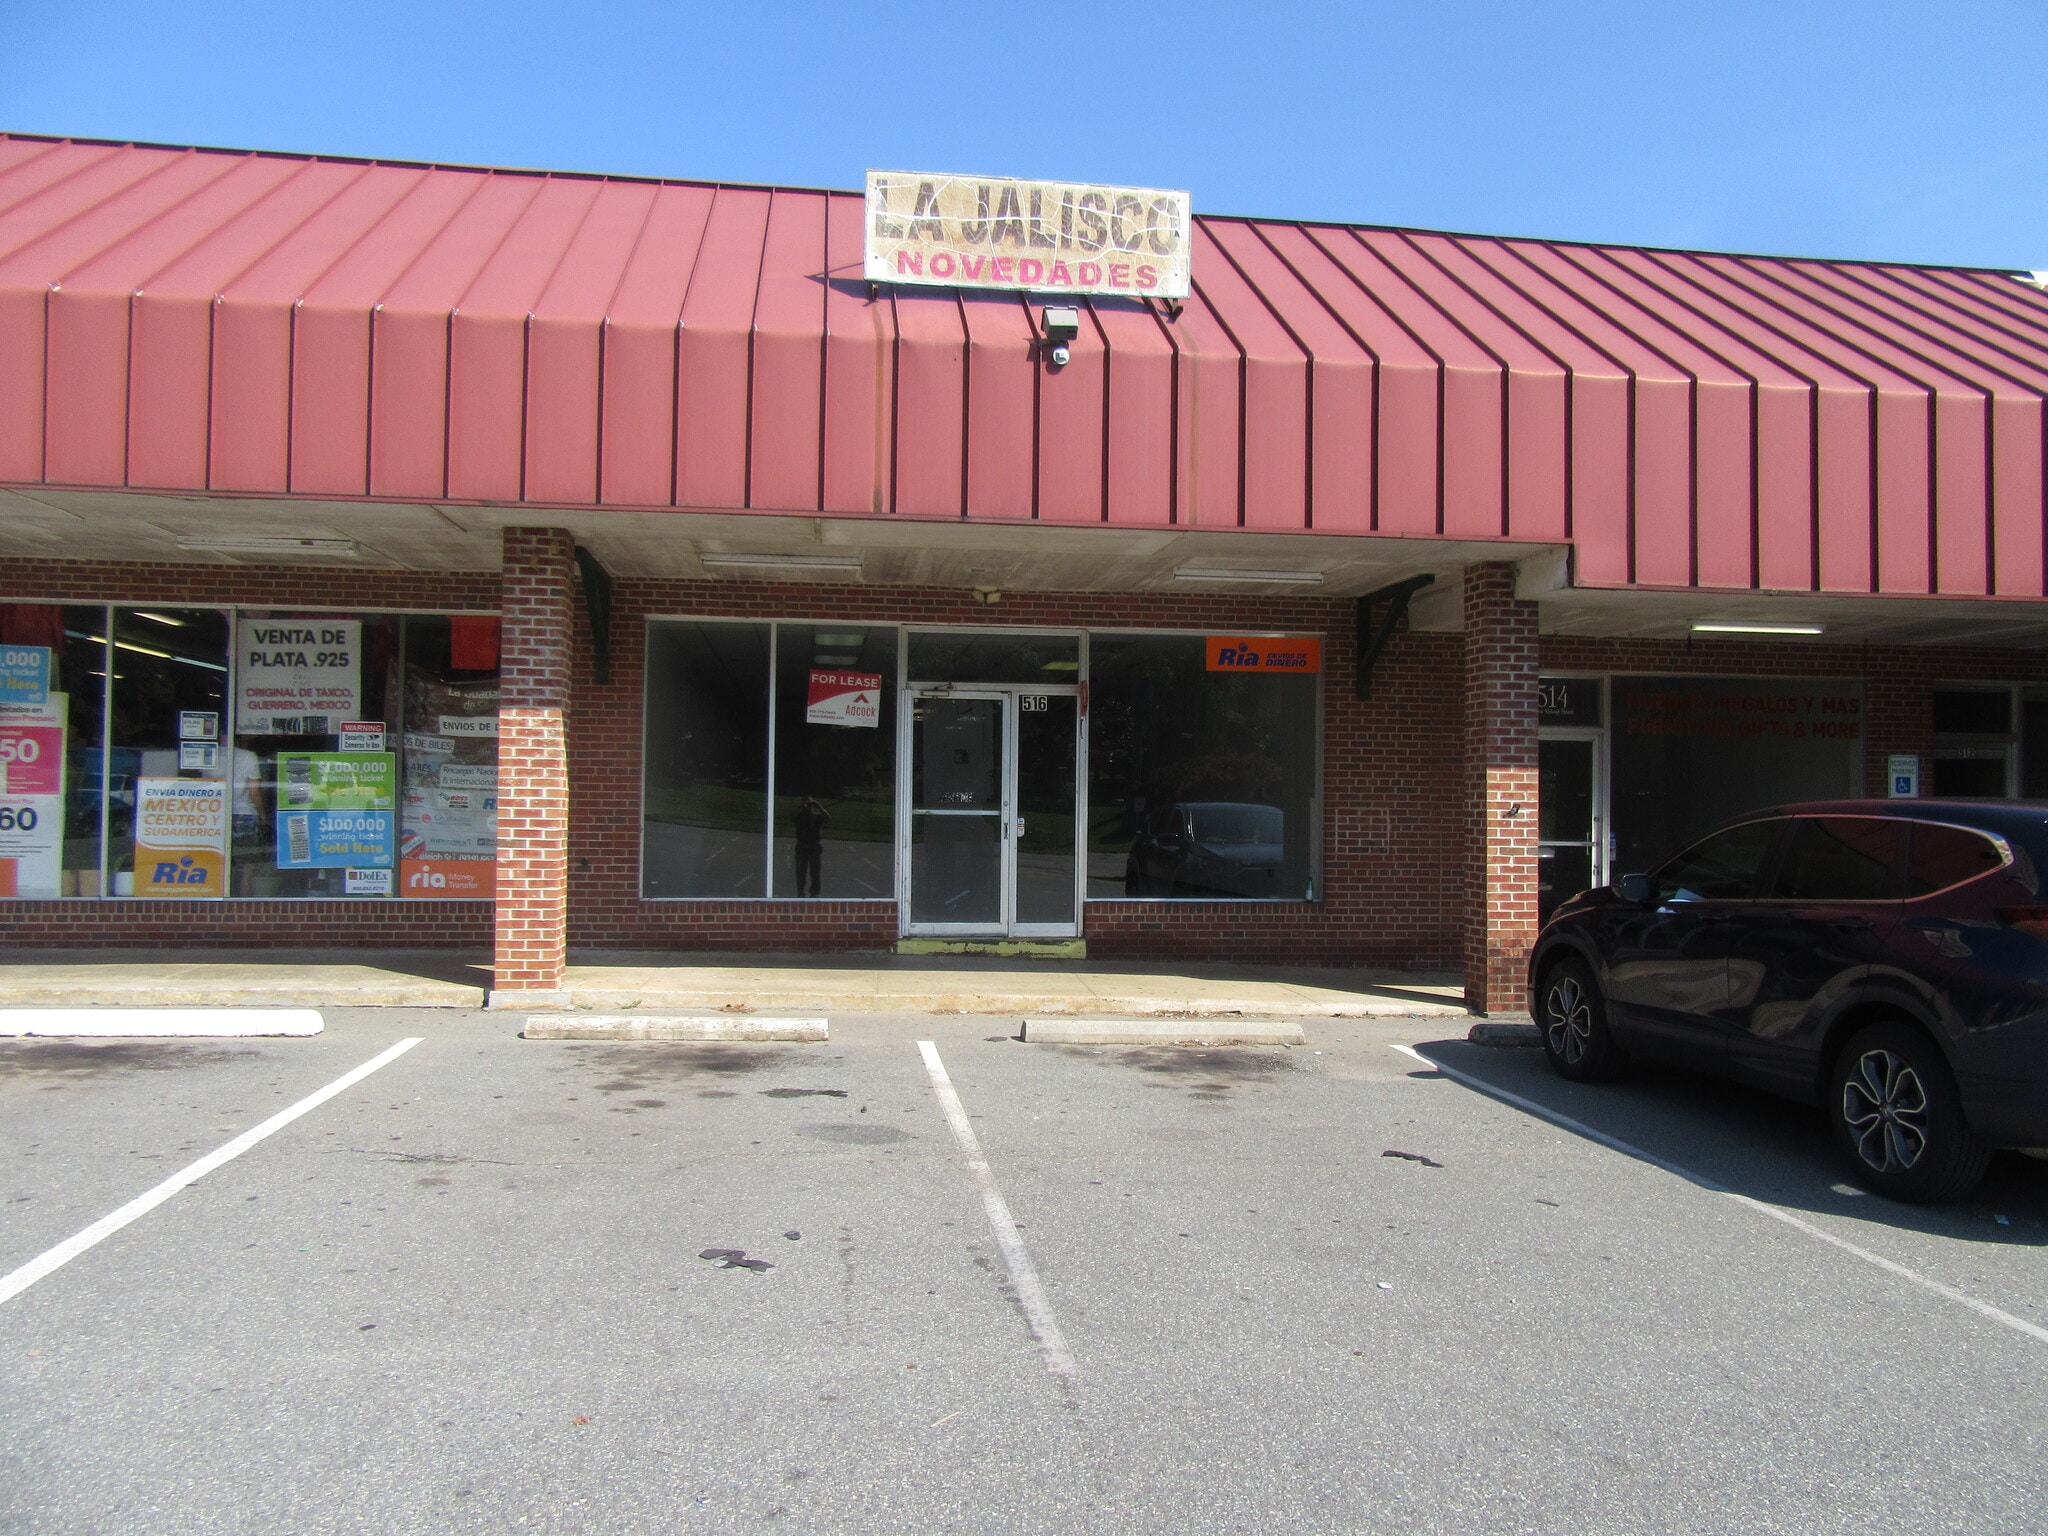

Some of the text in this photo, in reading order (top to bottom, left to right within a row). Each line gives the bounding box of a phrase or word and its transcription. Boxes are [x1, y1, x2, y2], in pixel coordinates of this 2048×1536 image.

[875, 178, 1180, 256] LA JALISCO
[897, 250, 1159, 290] NOVEDADES
[254, 629, 346, 645] VENTA DE
[250, 652, 350, 667] PLATA .925
[1217, 641, 1260, 667] Ria
[1265, 659, 1308, 667] DINERO
[811, 674, 878, 688] FOR LEASE
[246, 688, 354, 698] ORIGINAL DE TAXCO,
[1538, 685, 1567, 708] 514
[248, 701, 351, 710] GUERRERO, MEXICO
[1023, 696, 1047, 711] 516
[1802, 697, 1815, 714] Y
[1821, 697, 1860, 715] MAS
[845, 705, 876, 718] Adcock
[344, 724, 381, 732] WARNING
[442, 722, 475, 731] ENVIOS
[479, 723, 491, 731] DE
[1793, 721, 1806, 739] &
[1812, 721, 1860, 740] MORE
[387, 735, 413, 746] PAOS
[415, 737, 426, 747] DE
[145, 788, 222, 797] ENVIA DINERO A
[144, 799, 222, 813] MEXICO
[144, 813, 222, 826] CENTRO Y
[319, 817, 385, 832] $100,000
[144, 827, 222, 837] SUDAMERICA
[321, 832, 384, 841] winning ticket
[320, 842, 384, 853] Sold Here
[152, 855, 208, 884] Ria
[359, 871, 388, 881] DolEx
[410, 865, 446, 888] ria
[449, 881, 479, 889] Transfer
